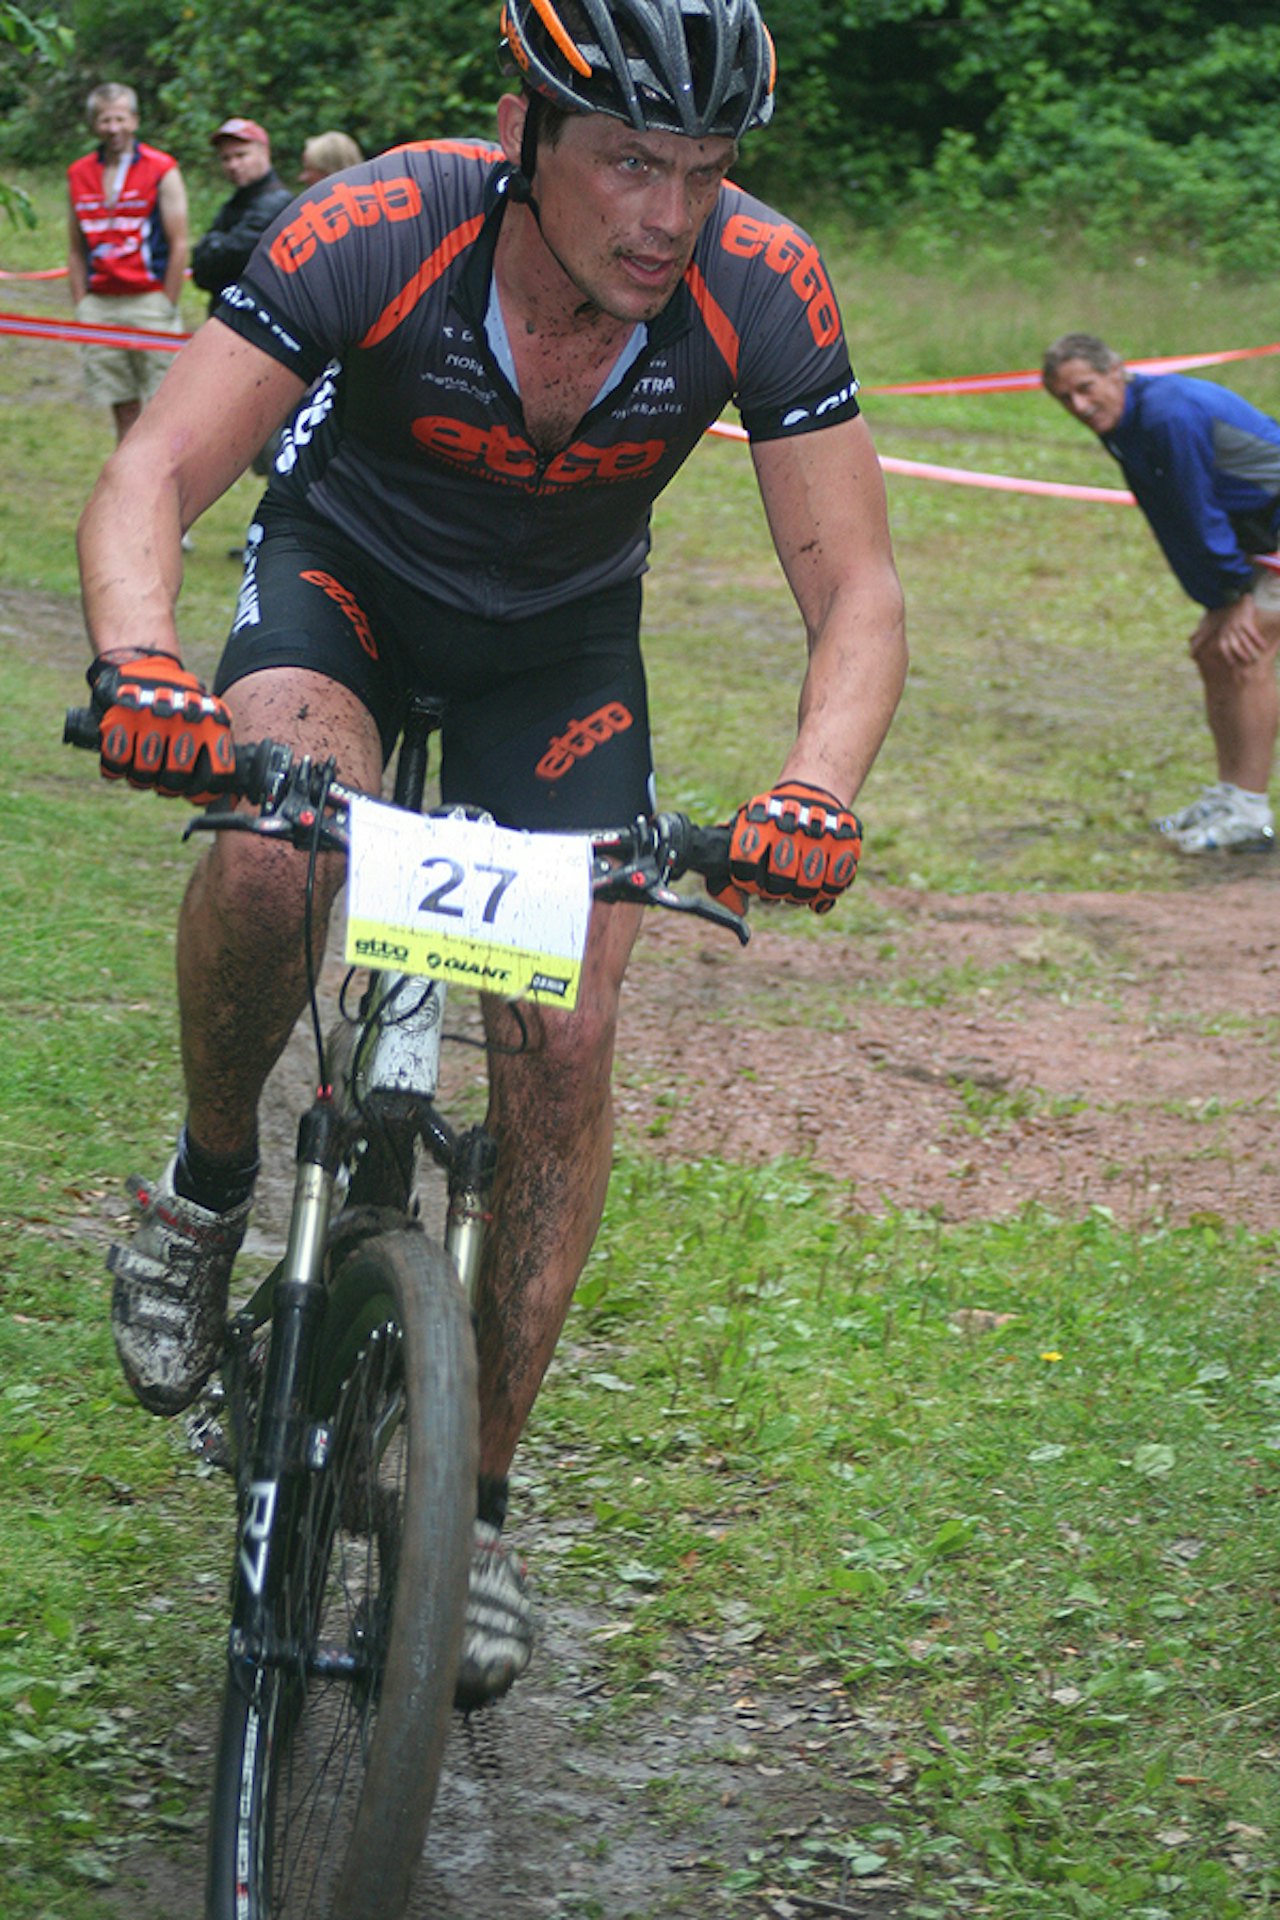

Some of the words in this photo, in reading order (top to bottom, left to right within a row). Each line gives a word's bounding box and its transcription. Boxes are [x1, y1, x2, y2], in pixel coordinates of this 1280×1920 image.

[268, 176, 423, 275] etto
[720, 214, 841, 350] etto
[535, 701, 633, 780] etto
[418, 857, 518, 924] 27
[443, 956, 513, 981] GIANT
